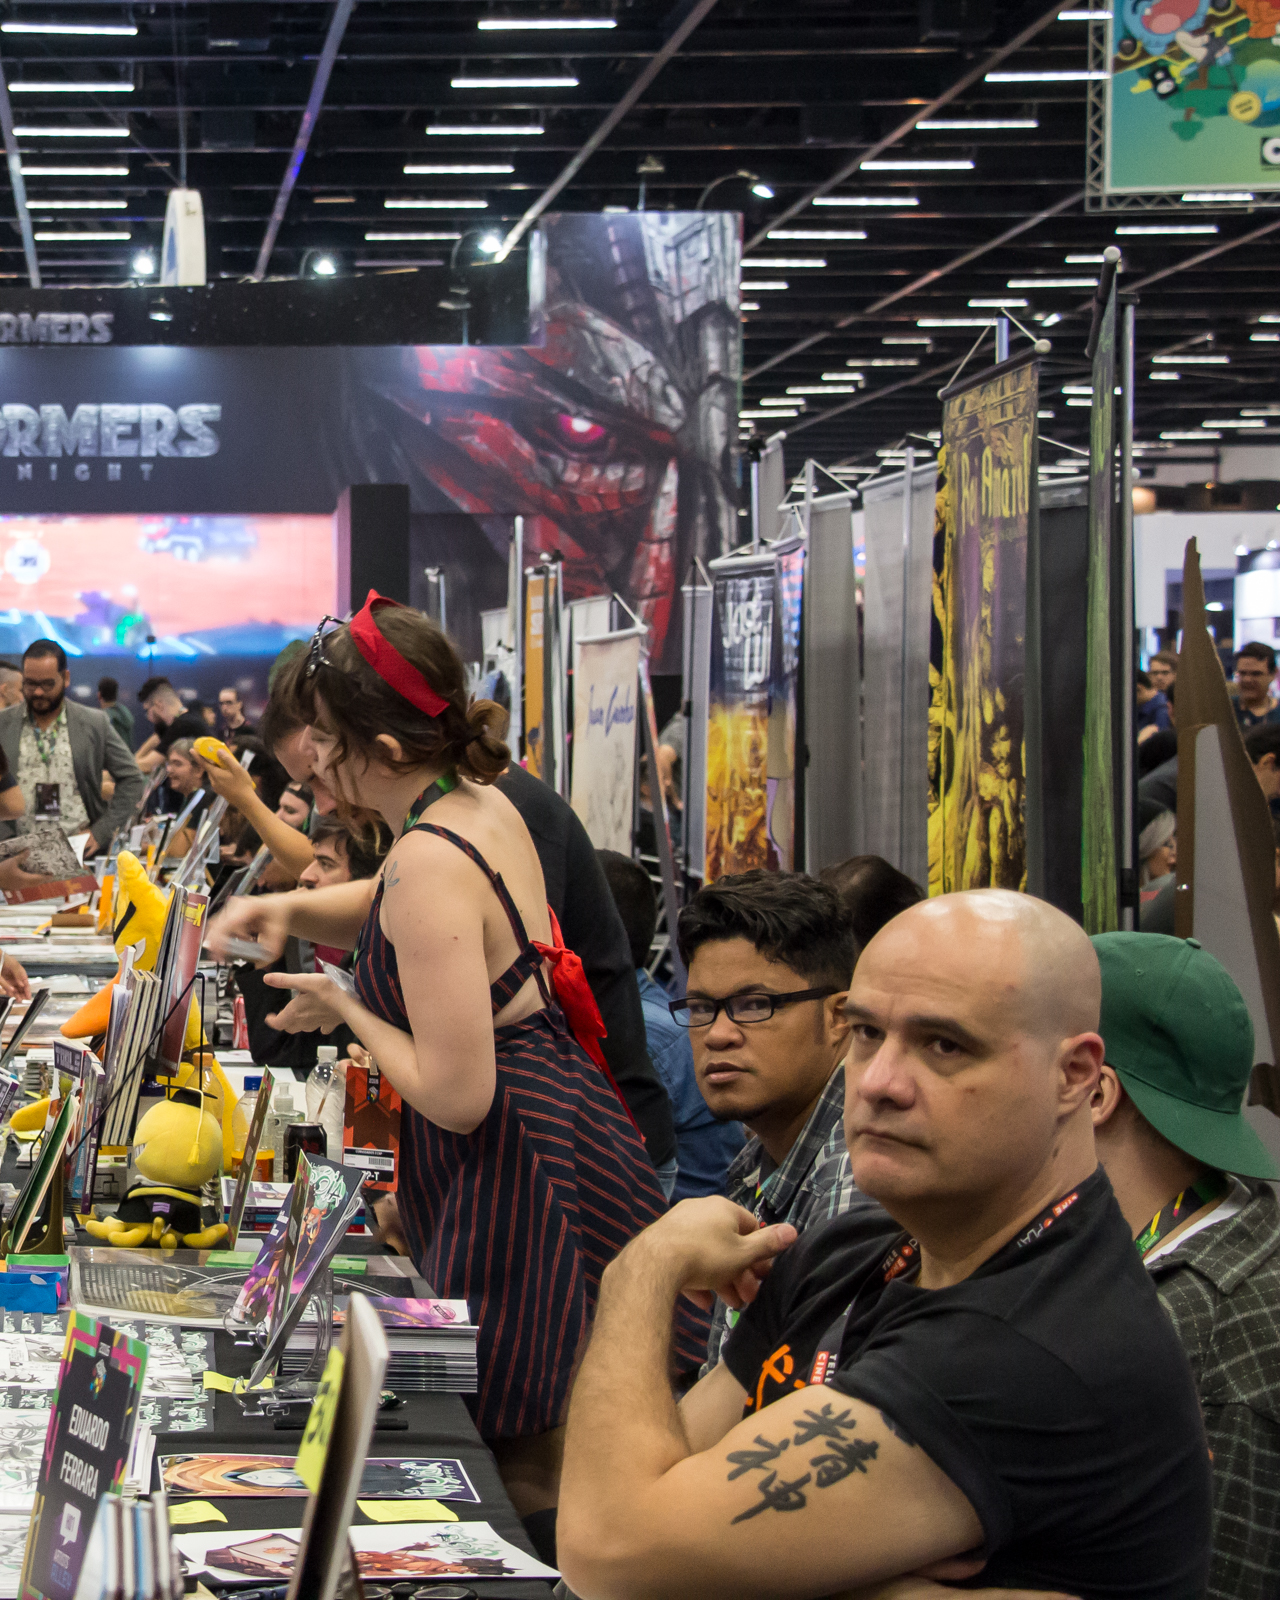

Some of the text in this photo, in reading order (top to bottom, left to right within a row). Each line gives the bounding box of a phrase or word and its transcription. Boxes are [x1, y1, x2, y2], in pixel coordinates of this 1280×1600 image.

[812, 1352, 827, 1383] CINE
[69, 1403, 110, 1451] EDUARDO
[59, 1450, 100, 1500] FERRARA
